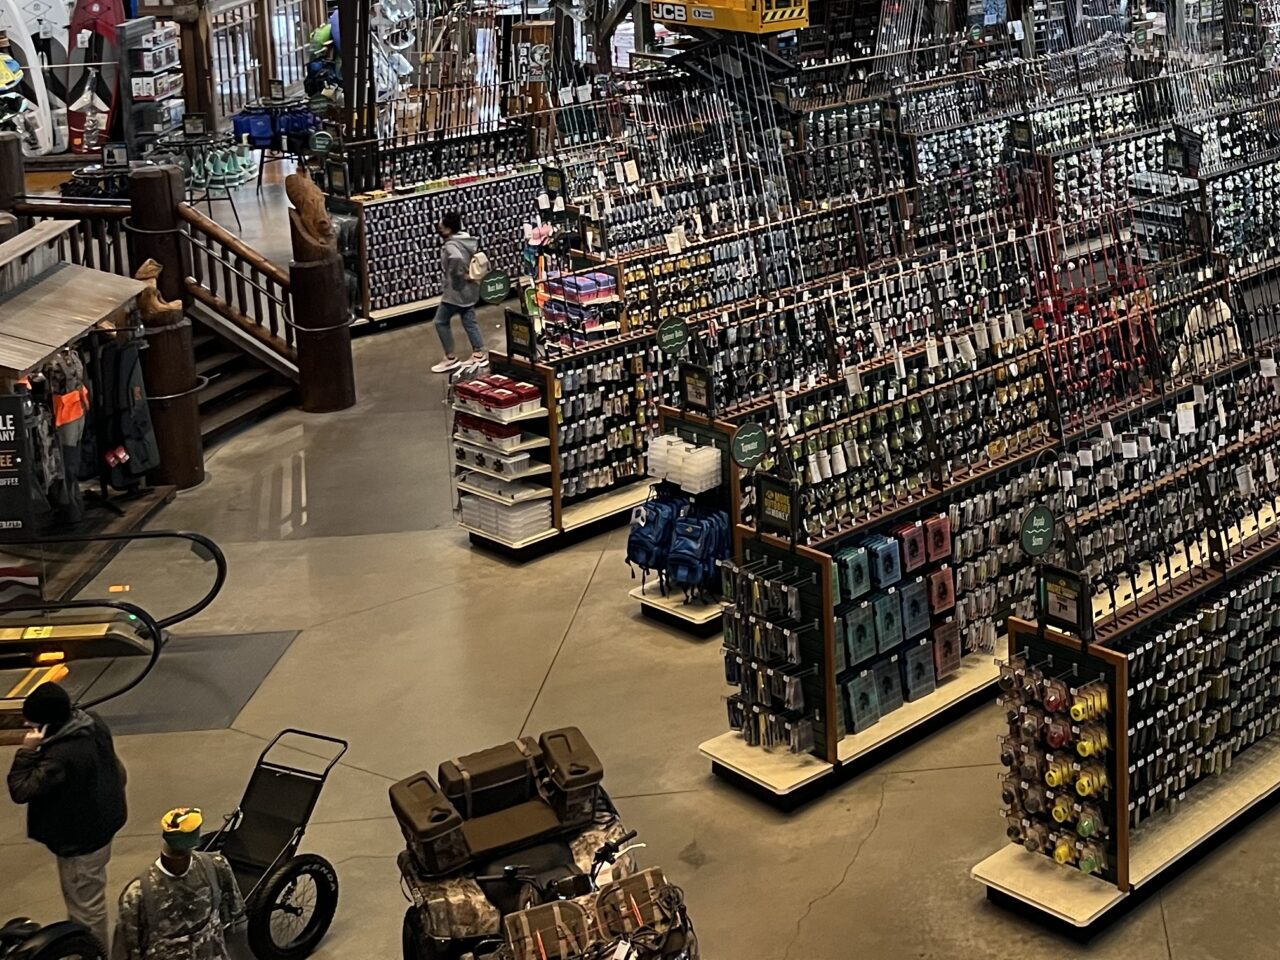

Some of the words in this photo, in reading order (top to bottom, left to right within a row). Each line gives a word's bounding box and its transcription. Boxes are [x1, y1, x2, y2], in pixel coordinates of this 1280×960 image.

[652, 3, 688, 22] JCB
[519, 47, 528, 82] BAIT
[302, 863, 337, 892] KENDA
